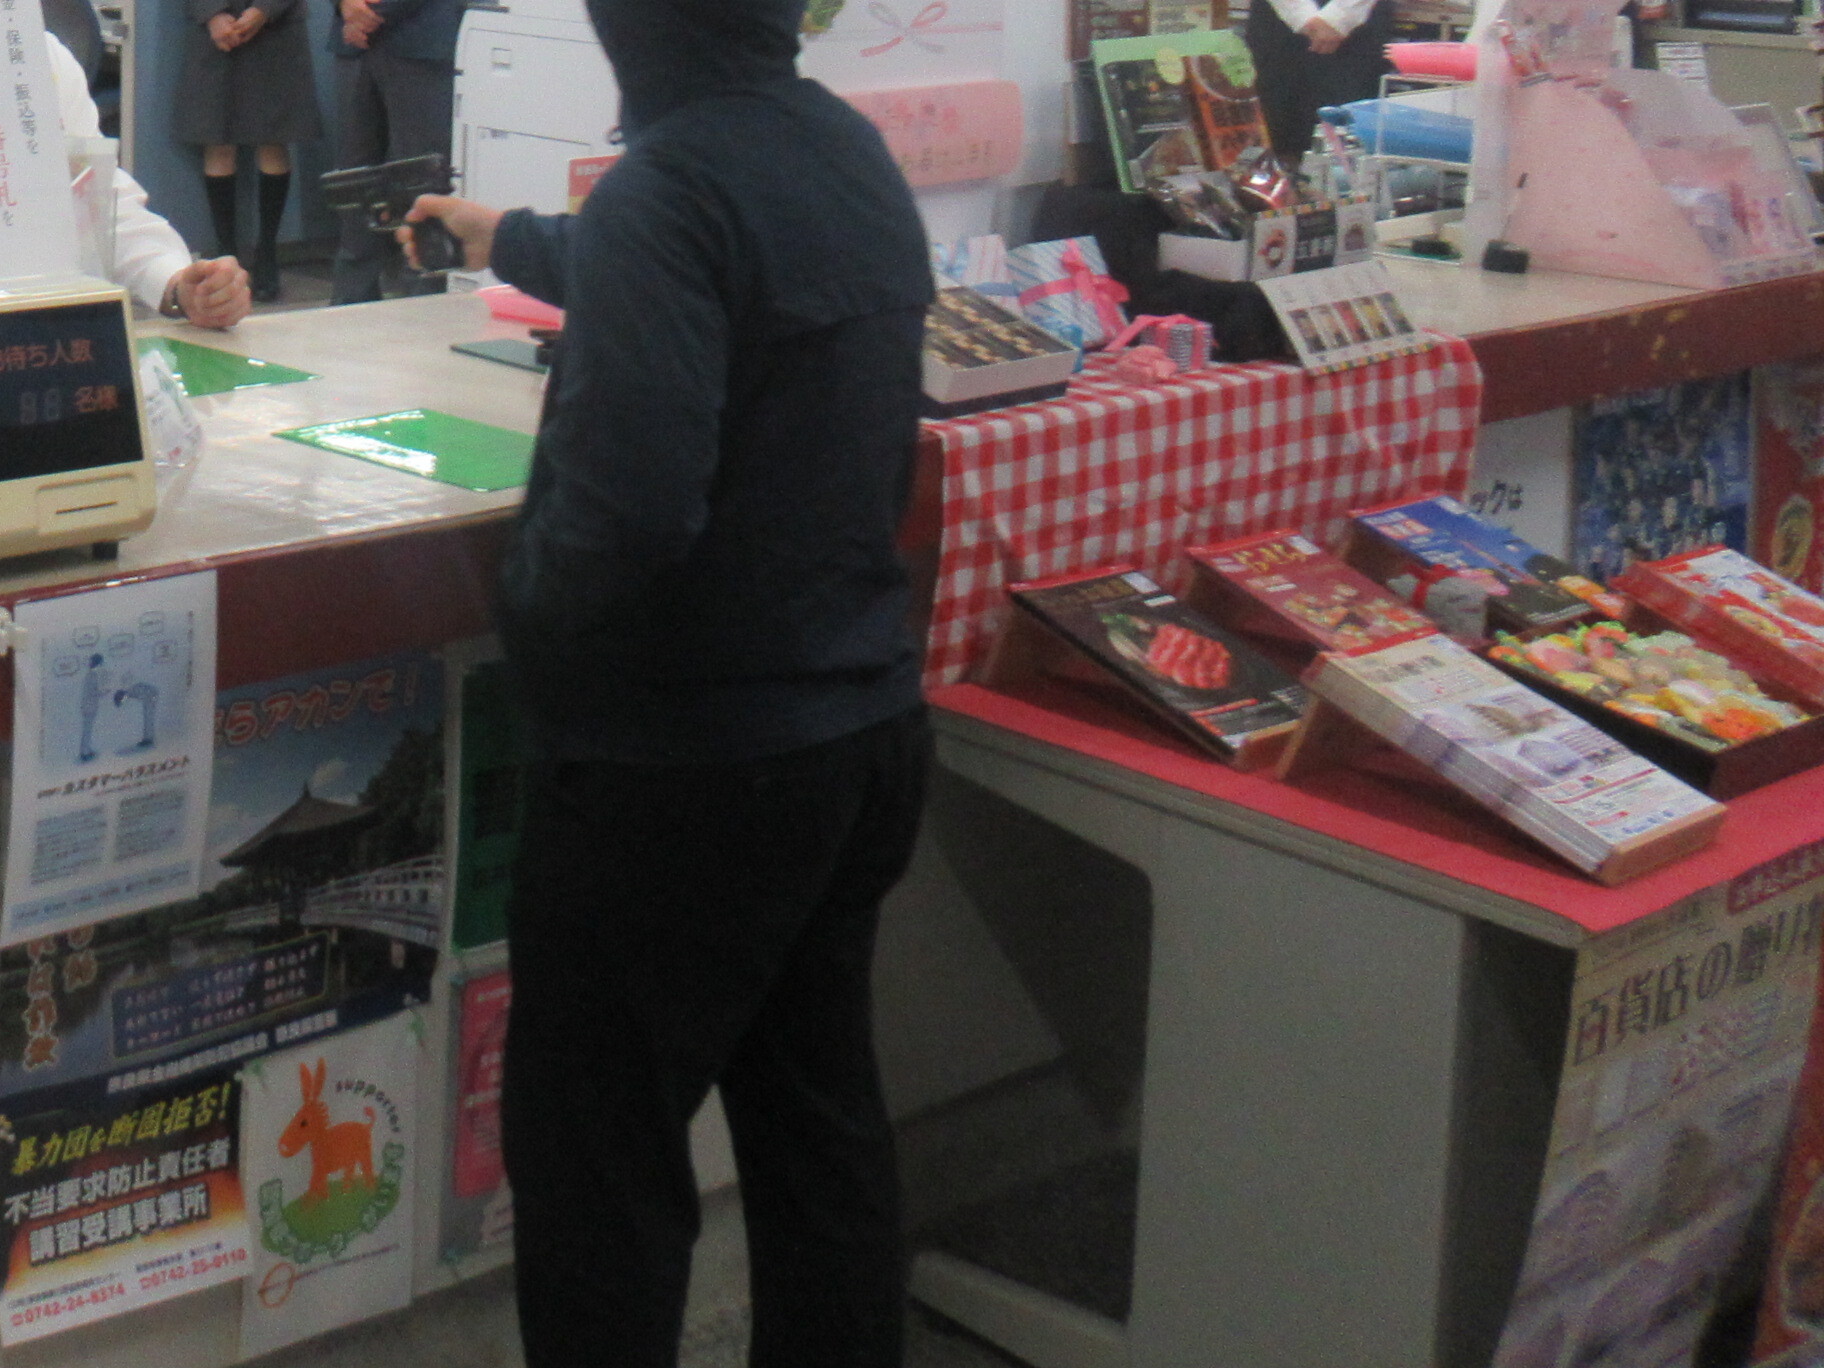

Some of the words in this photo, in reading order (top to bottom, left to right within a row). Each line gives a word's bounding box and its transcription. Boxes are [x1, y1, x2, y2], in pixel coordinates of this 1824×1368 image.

[10, 1080, 232, 1176] 暴力団を断固拒否!
[3, 1135, 231, 1227] 不当要求防止責任者
[28, 1182, 208, 1263] 講習受講事業所
